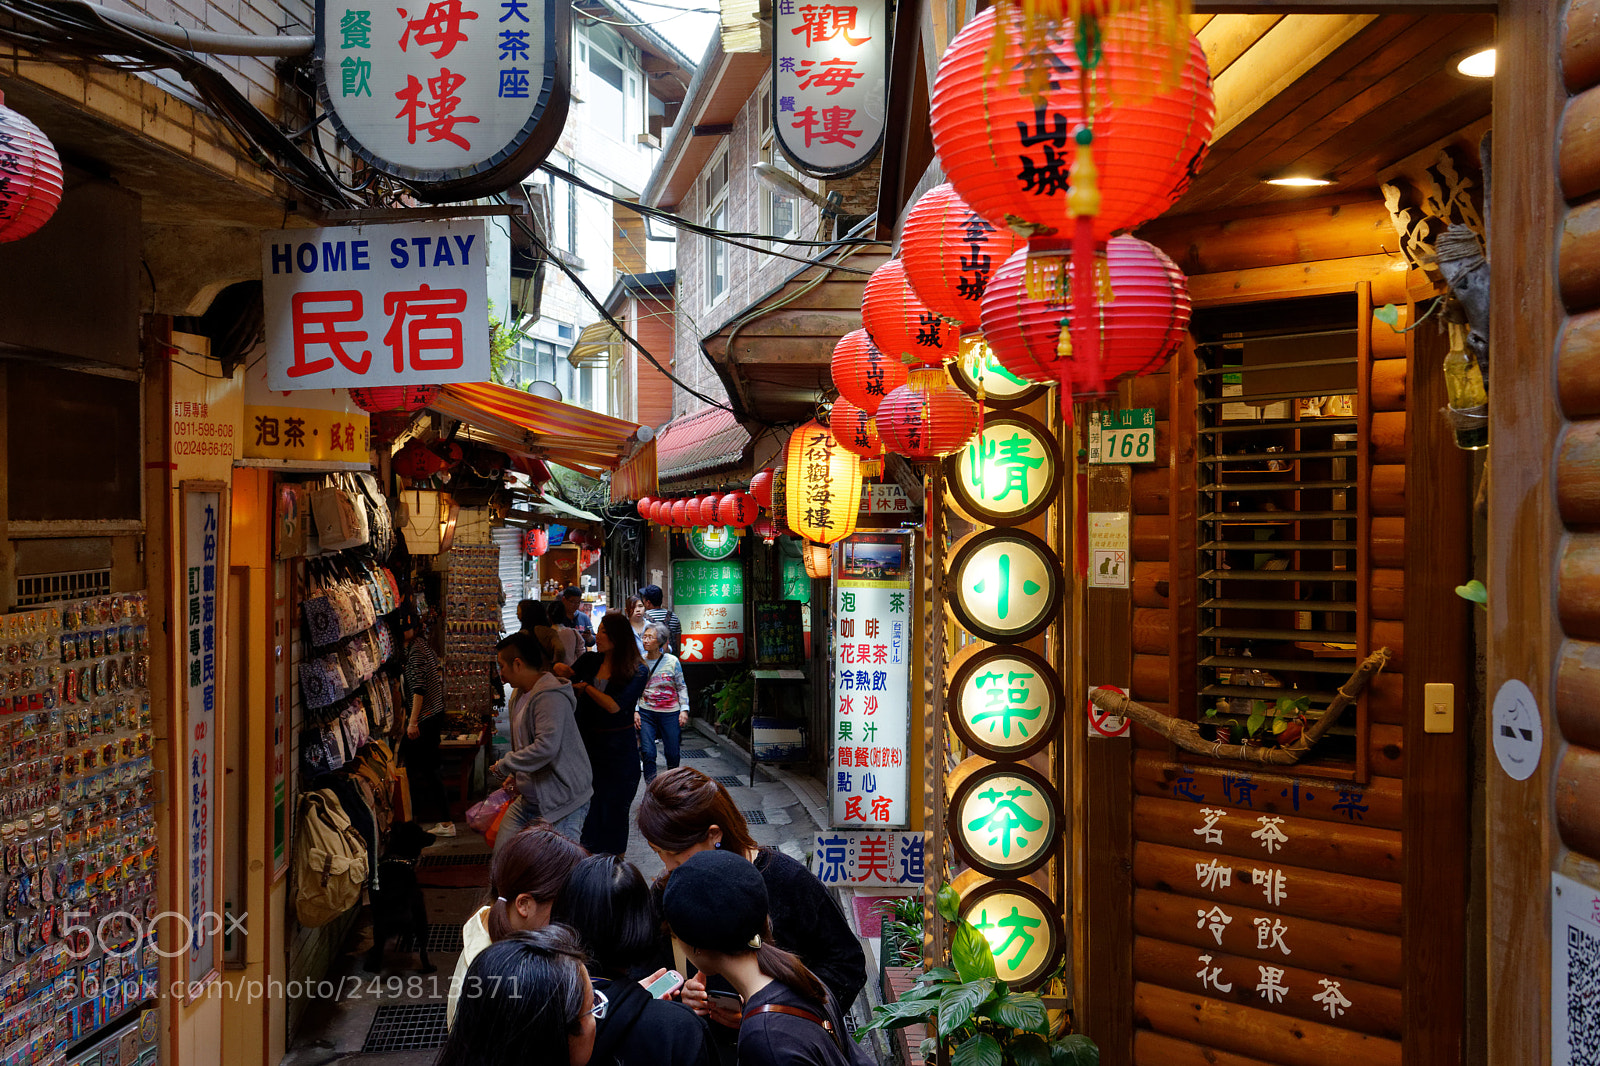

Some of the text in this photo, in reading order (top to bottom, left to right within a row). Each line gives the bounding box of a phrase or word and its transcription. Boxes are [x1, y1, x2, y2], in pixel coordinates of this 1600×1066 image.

[340, 9, 371, 98] 餐飲
[395, 0, 480, 151] 海樓
[791, 4, 872, 149] 觀海樓
[271, 234, 476, 274] HOME STAY
[286, 283, 468, 378] 民宿
[174, 421, 233, 438] 0911-598-608
[255, 415, 305, 448] 泡茶
[330, 422, 356, 453] 民宿
[1107, 432, 1150, 458] 168
[803, 433, 838, 530] 九份觀海樓
[693, 536, 719, 556] COFFEE
[725, 536, 737, 552] TEA
[840, 618, 880, 640] 咖啡
[679, 637, 739, 660] 火鍋
[839, 643, 888, 665] 花果茶
[968, 342, 1045, 971] 情小築茶坊
[839, 670, 887, 692] 冷熱飲
[838, 694, 878, 717] 冰沙
[838, 721, 878, 743] 果汁
[837, 771, 877, 794] 點心
[843, 795, 893, 823] 民宿
[1193, 807, 1289, 854] 茗茶
[1195, 858, 1288, 906] 咖啡
[1196, 905, 1292, 955] 冷飲
[1196, 953, 1352, 1019] 花果茶
